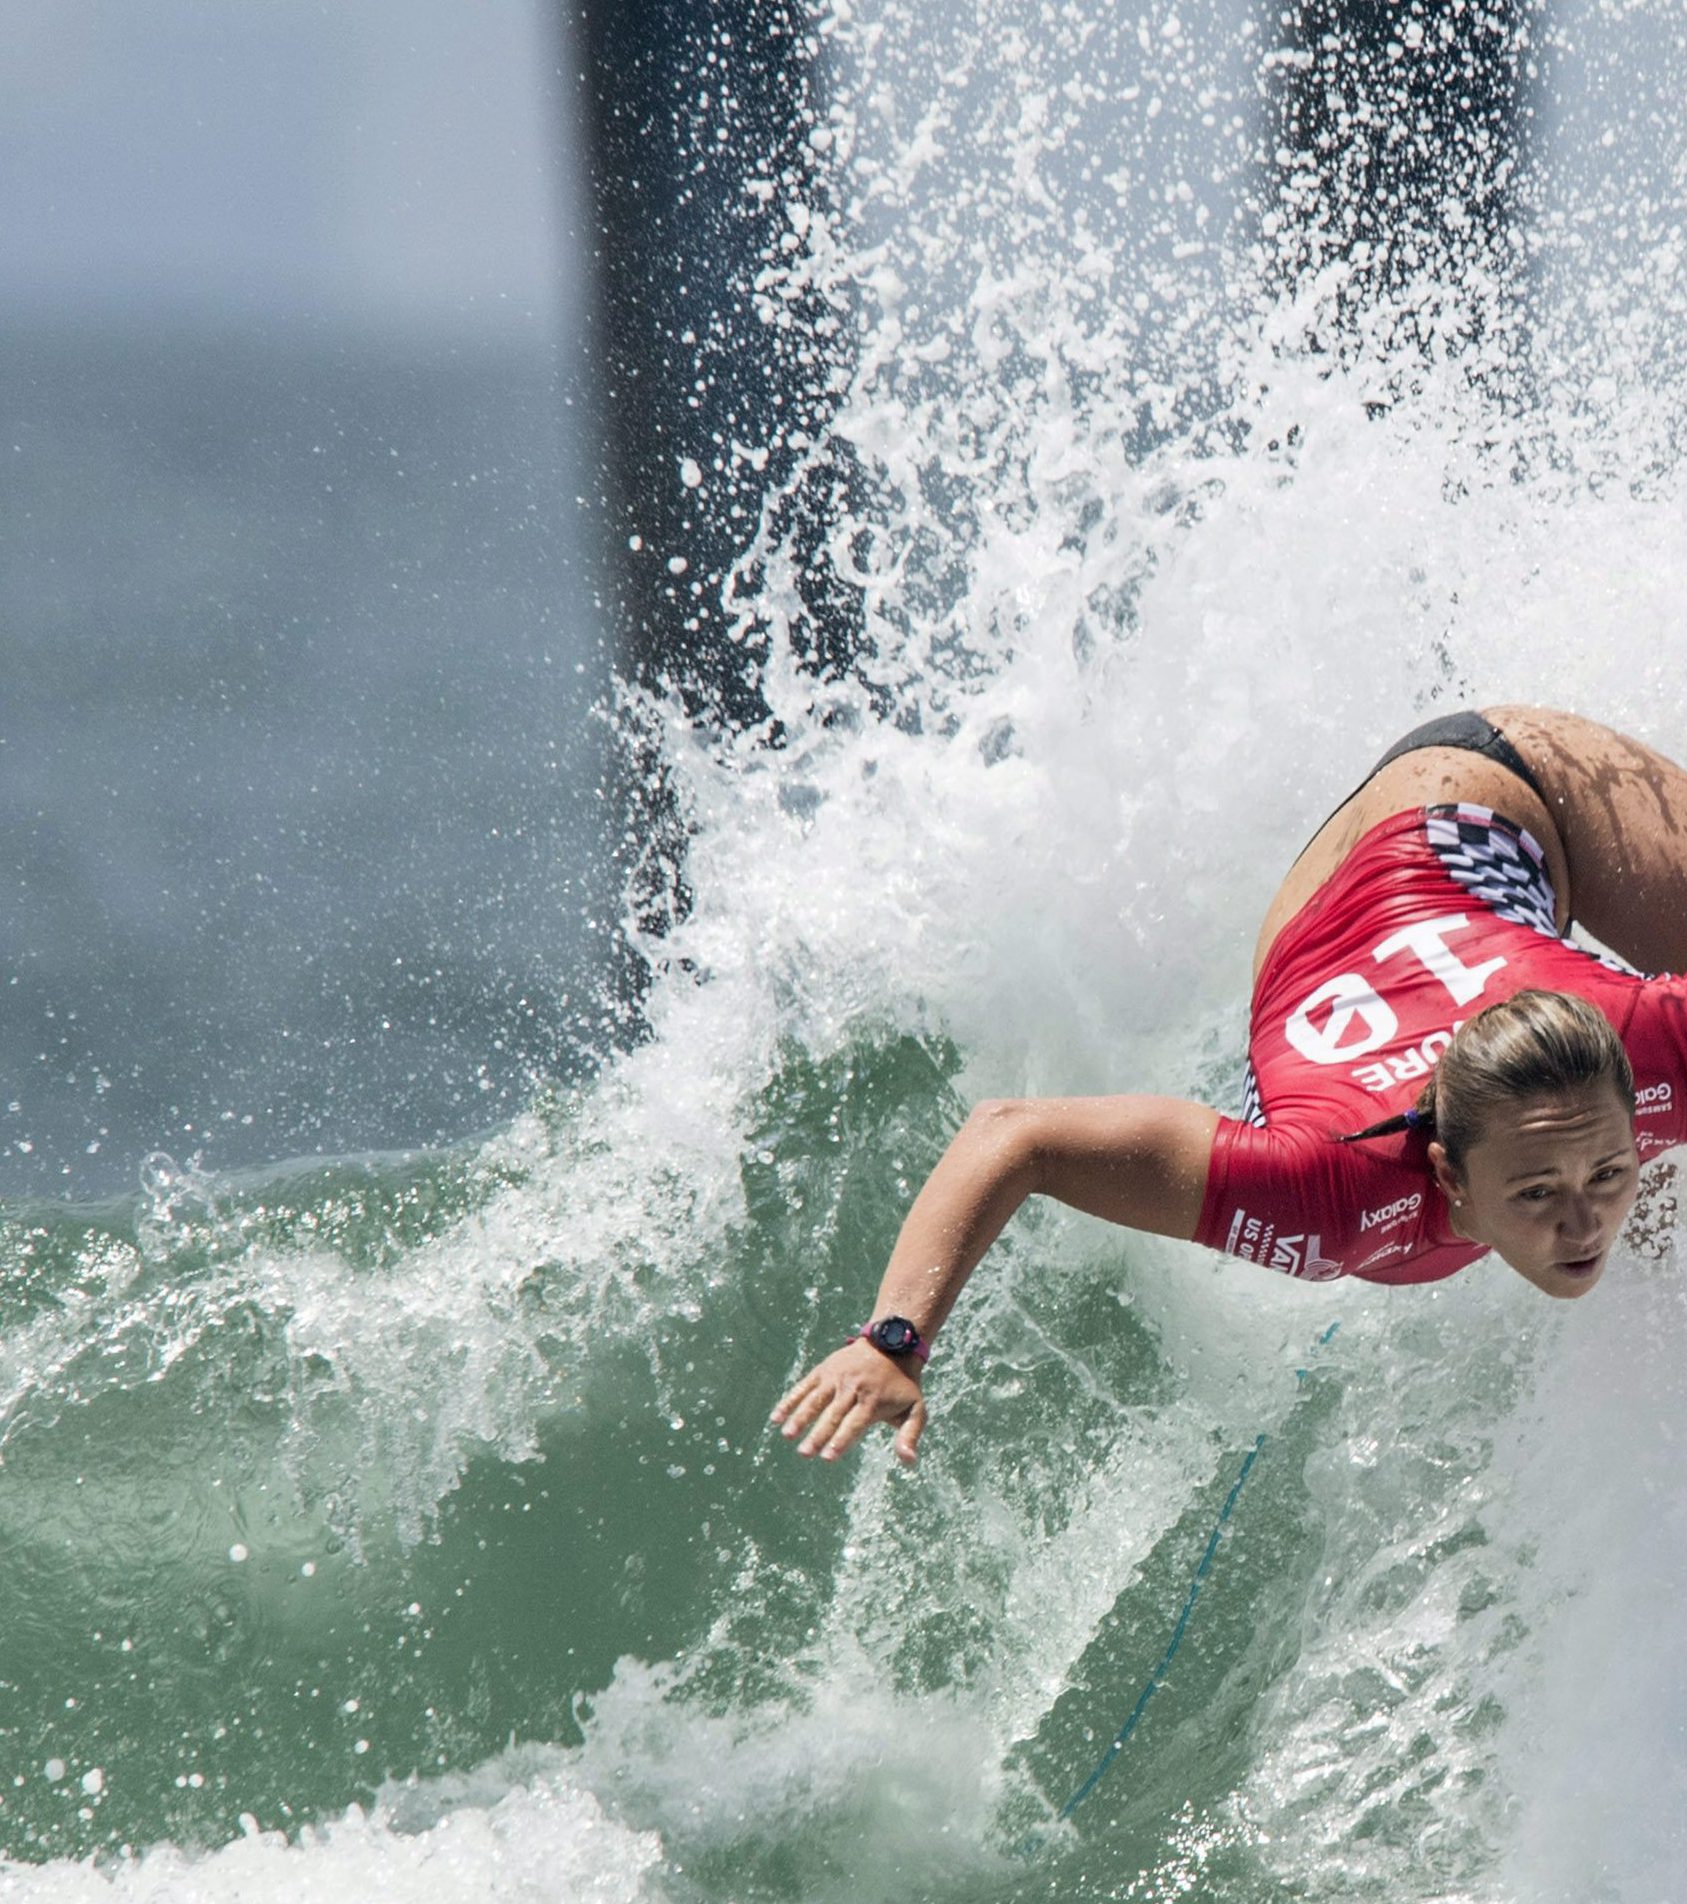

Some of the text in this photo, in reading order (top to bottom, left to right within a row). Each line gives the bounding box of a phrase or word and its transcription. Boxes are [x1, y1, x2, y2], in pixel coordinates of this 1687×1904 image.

[1285, 913, 1508, 1064] 10
[1244, 1218, 1262, 1241] US
[1360, 1193, 1422, 1232] Galaxy
